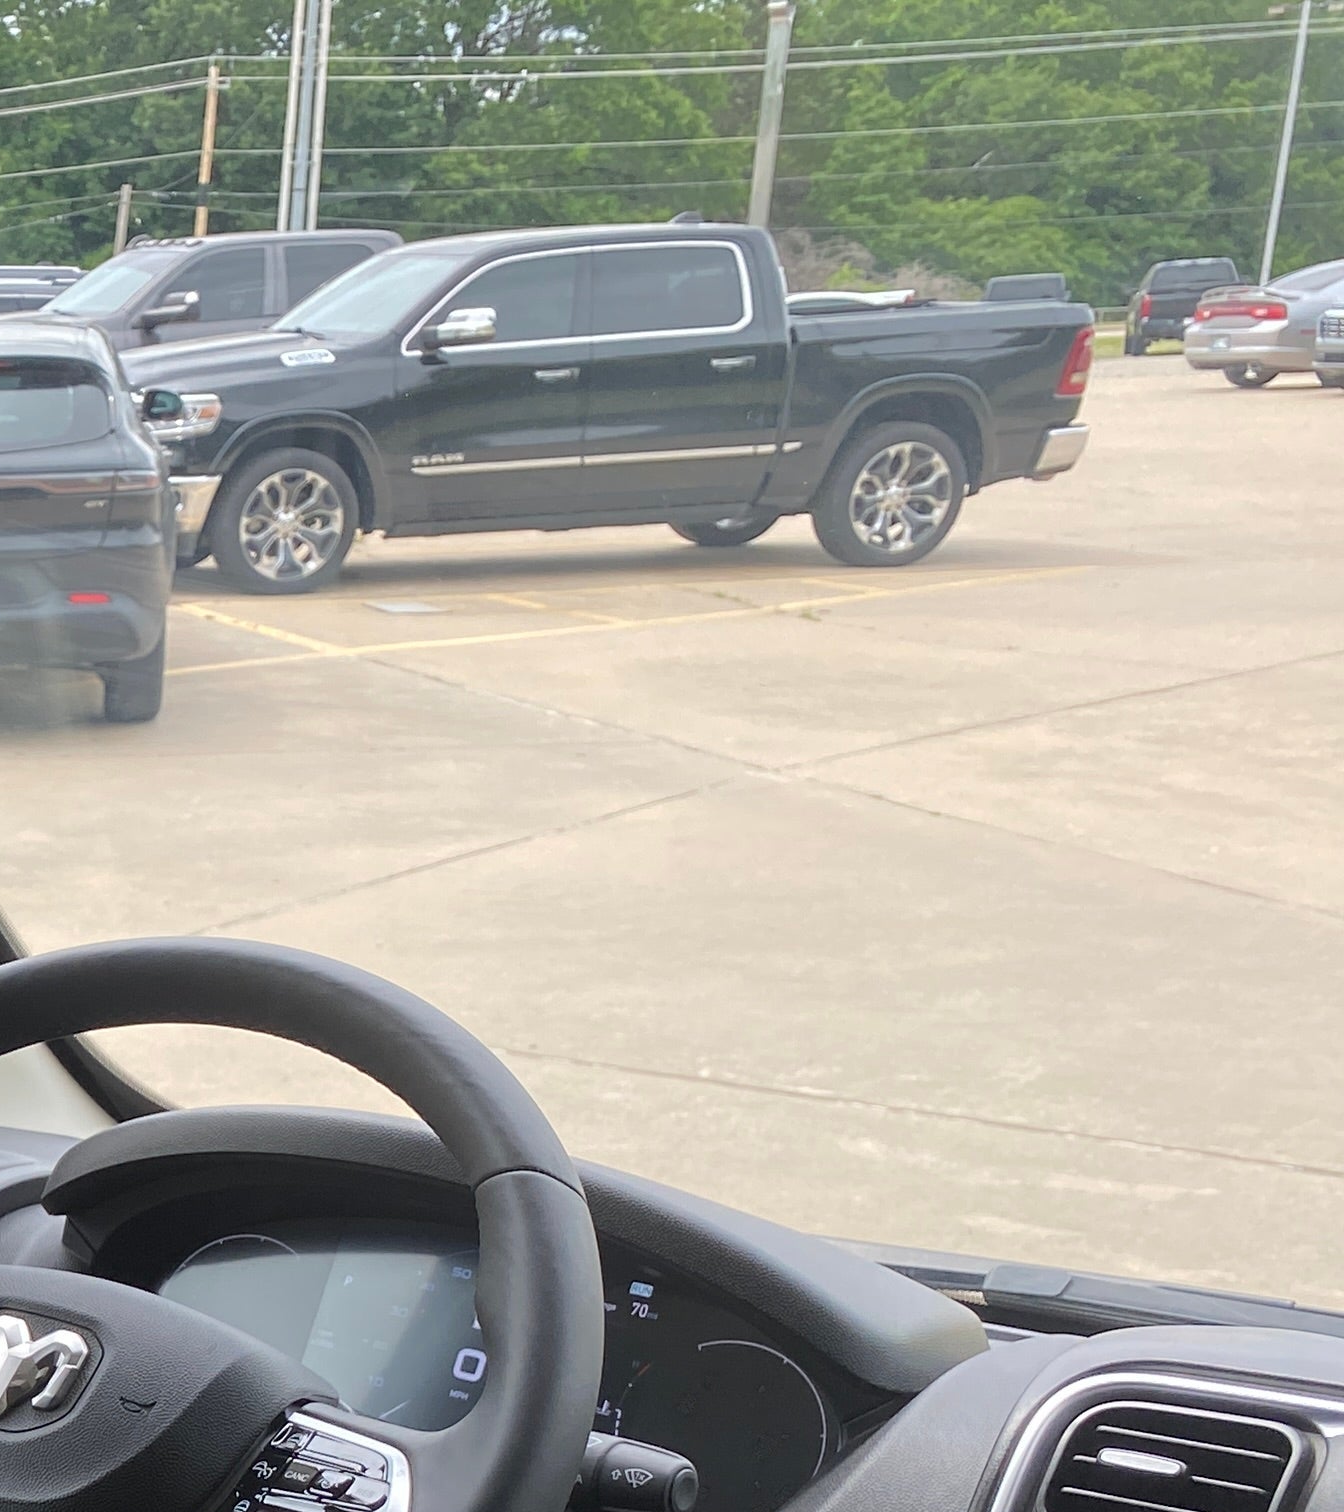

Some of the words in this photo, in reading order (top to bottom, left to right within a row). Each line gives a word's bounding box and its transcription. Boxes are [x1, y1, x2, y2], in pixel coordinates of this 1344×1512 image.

[451, 1266, 473, 1280] 50
[343, 1275, 353, 1287] P
[631, 1283, 653, 1296] RUN
[630, 1301, 649, 1319] 70
[452, 1347, 488, 1383] 0
[448, 1389, 470, 1401] MPH
[284, 1470, 310, 1482] CANC
